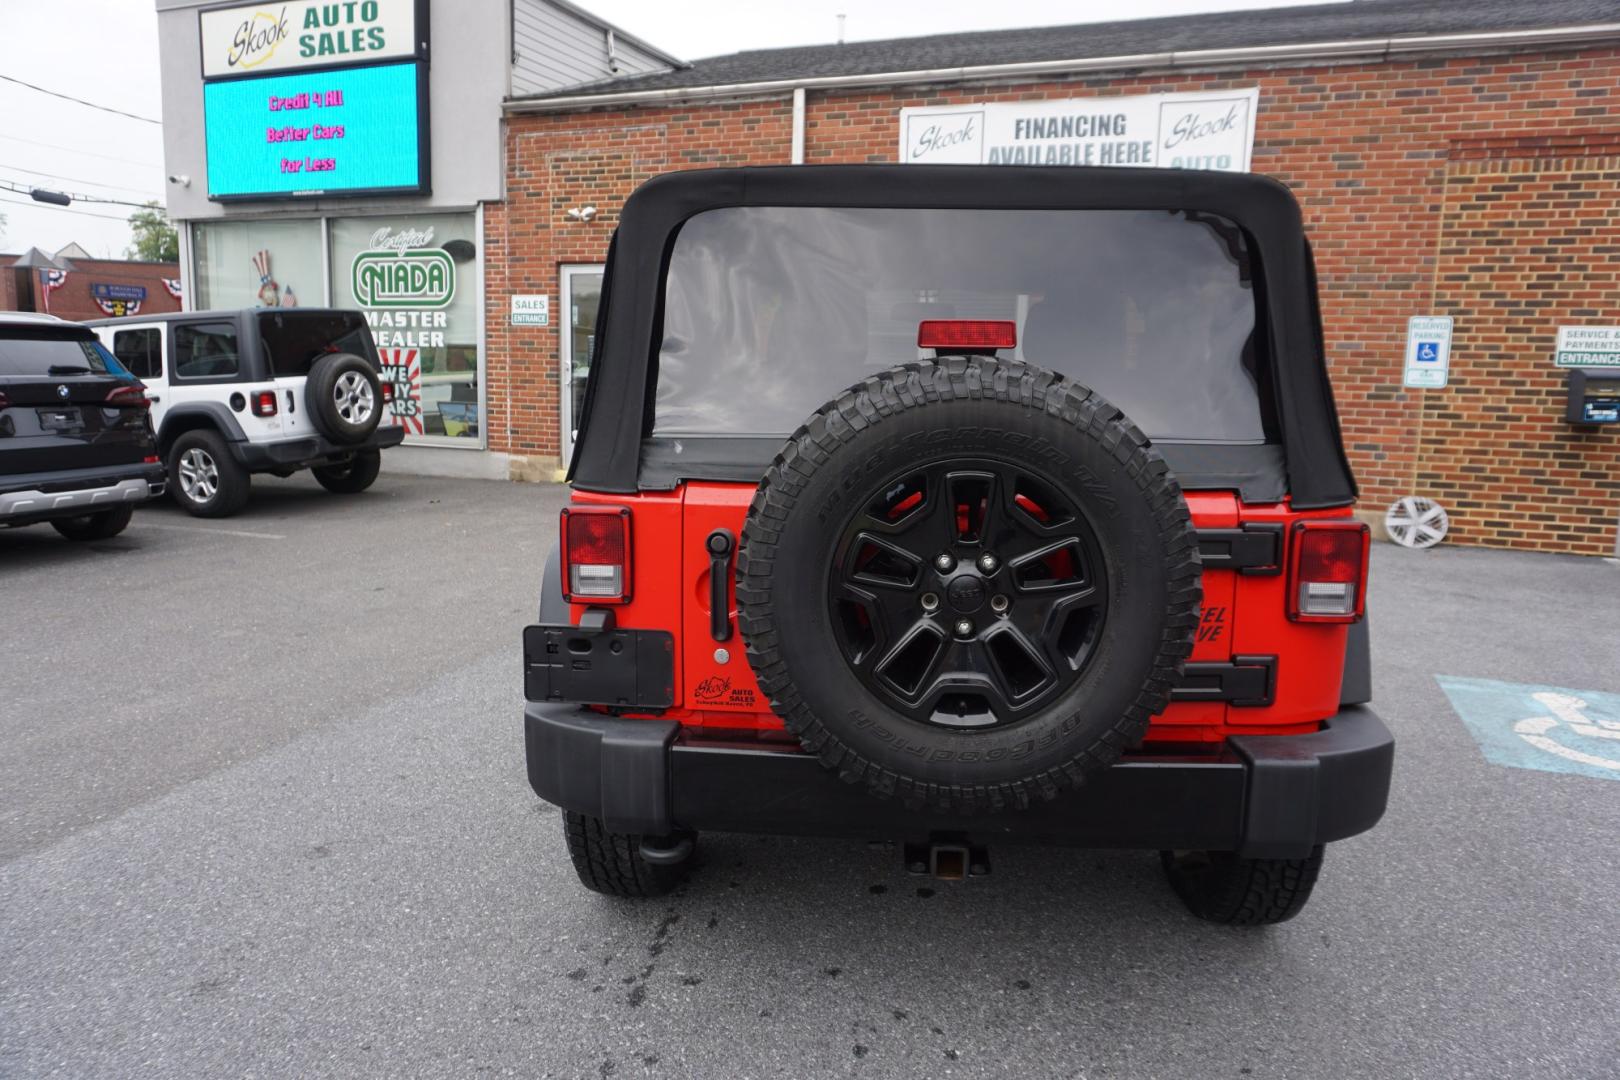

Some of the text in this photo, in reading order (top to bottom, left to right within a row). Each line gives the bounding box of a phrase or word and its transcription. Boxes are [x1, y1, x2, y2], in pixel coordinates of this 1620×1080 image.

[303, 0, 379, 29] AUTO
[228, 6, 289, 66] Skook
[299, 27, 386, 58] SALES
[268, 90, 344, 111] Credit 4 All
[266, 124, 344, 143] Better Cars
[1014, 114, 1127, 140] FINANCING
[1164, 105, 1239, 149] Skook
[912, 117, 975, 158] Skook
[988, 141, 1153, 166] AVAILABLE HERE
[1171, 154, 1232, 170] AUTO
[280, 157, 336, 173] for Less
[370, 226, 435, 257] Certified
[360, 261, 446, 300] NIADA
[514, 300, 545, 310] SALES
[363, 311, 447, 328] MASTER
[513, 314, 546, 323] ENTRANCE
[1567, 330, 1609, 338] SERVICE
[1566, 341, 1620, 350] PAYMENTS
[1561, 353, 1620, 363] ENTRANCE
[381, 366, 408, 381] WE
[388, 400, 416, 414] ARS
